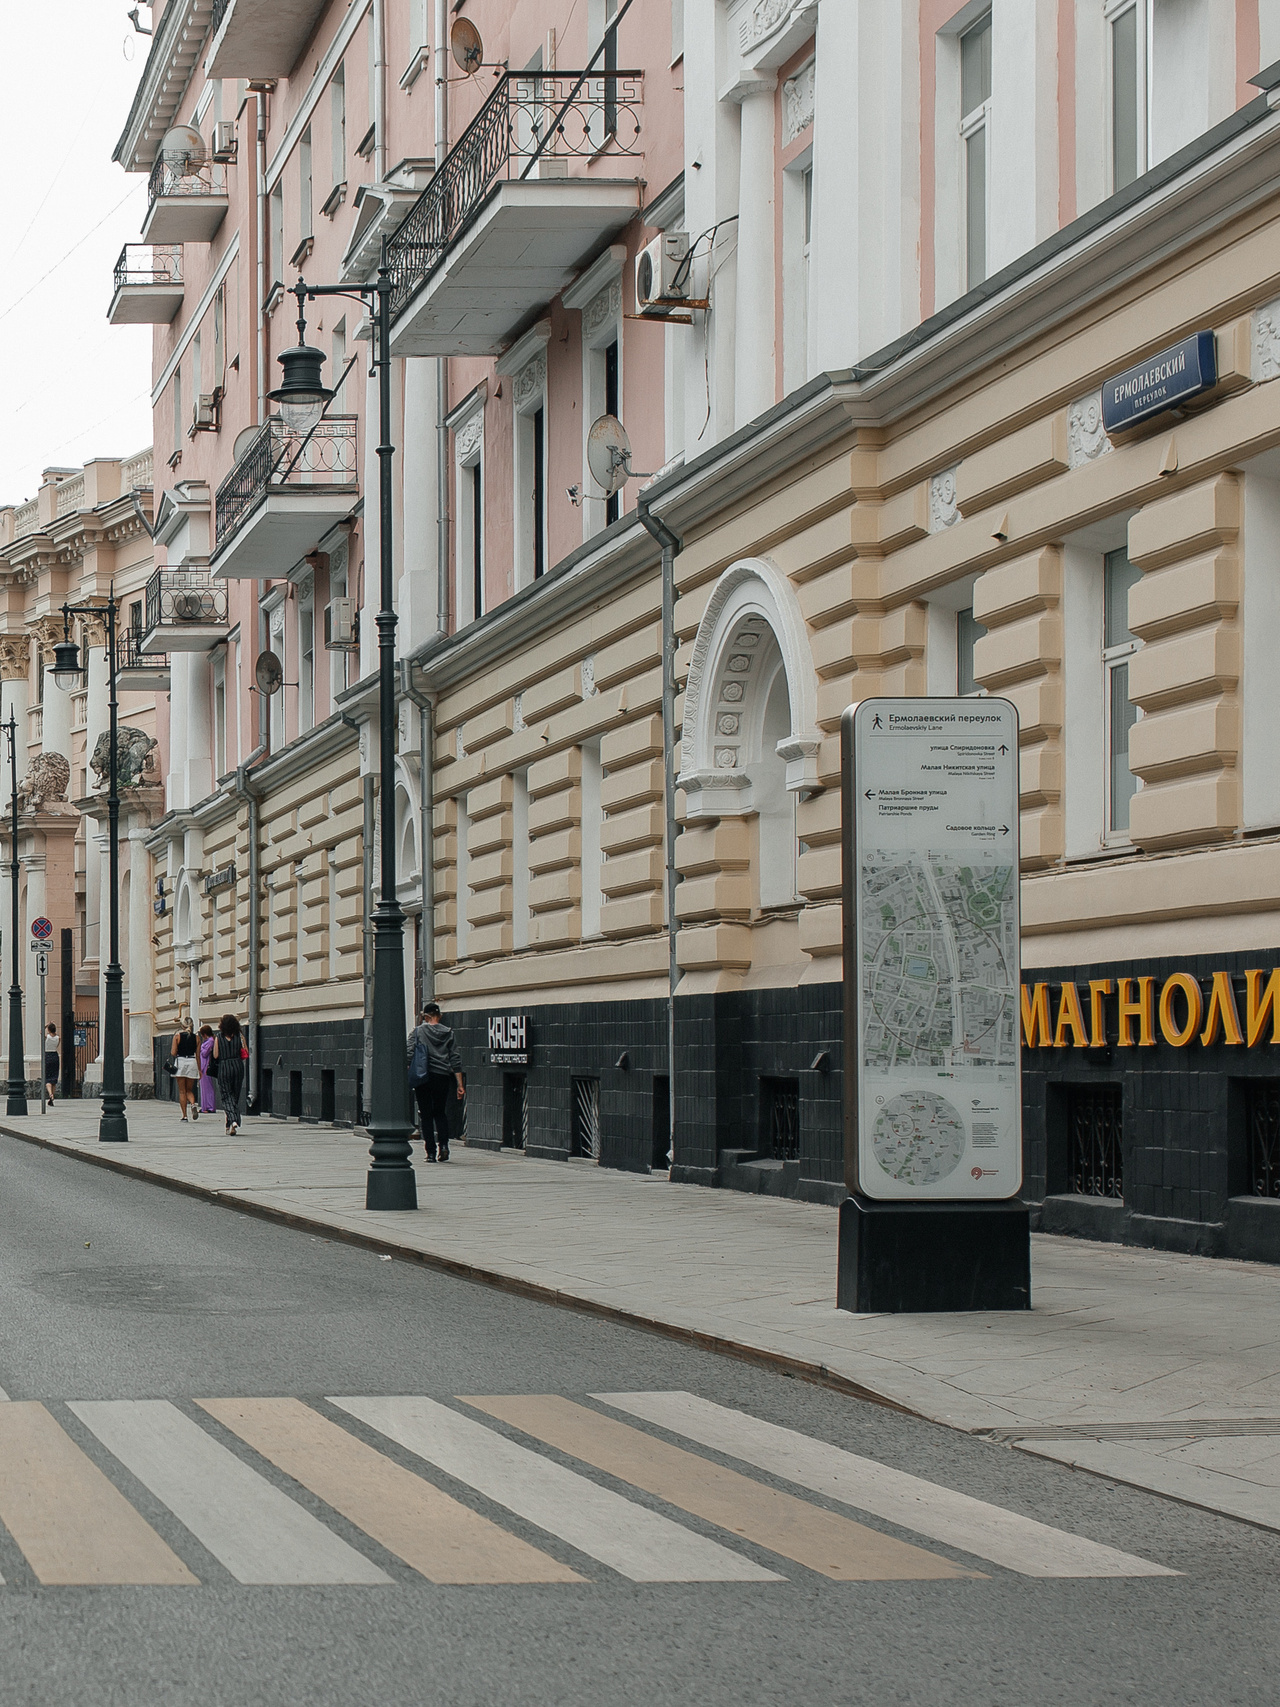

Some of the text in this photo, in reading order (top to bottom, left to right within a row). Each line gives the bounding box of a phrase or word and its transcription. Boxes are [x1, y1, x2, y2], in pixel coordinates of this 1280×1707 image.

[1114, 351, 1186, 404] ЕРМОЛАЕВСКИЙ
[1134, 386, 1167, 409] ПЕРЕУЛОК
[889, 714, 1001, 724] Ермолаевский переулок
[488, 1015, 526, 1049] KRUSH
